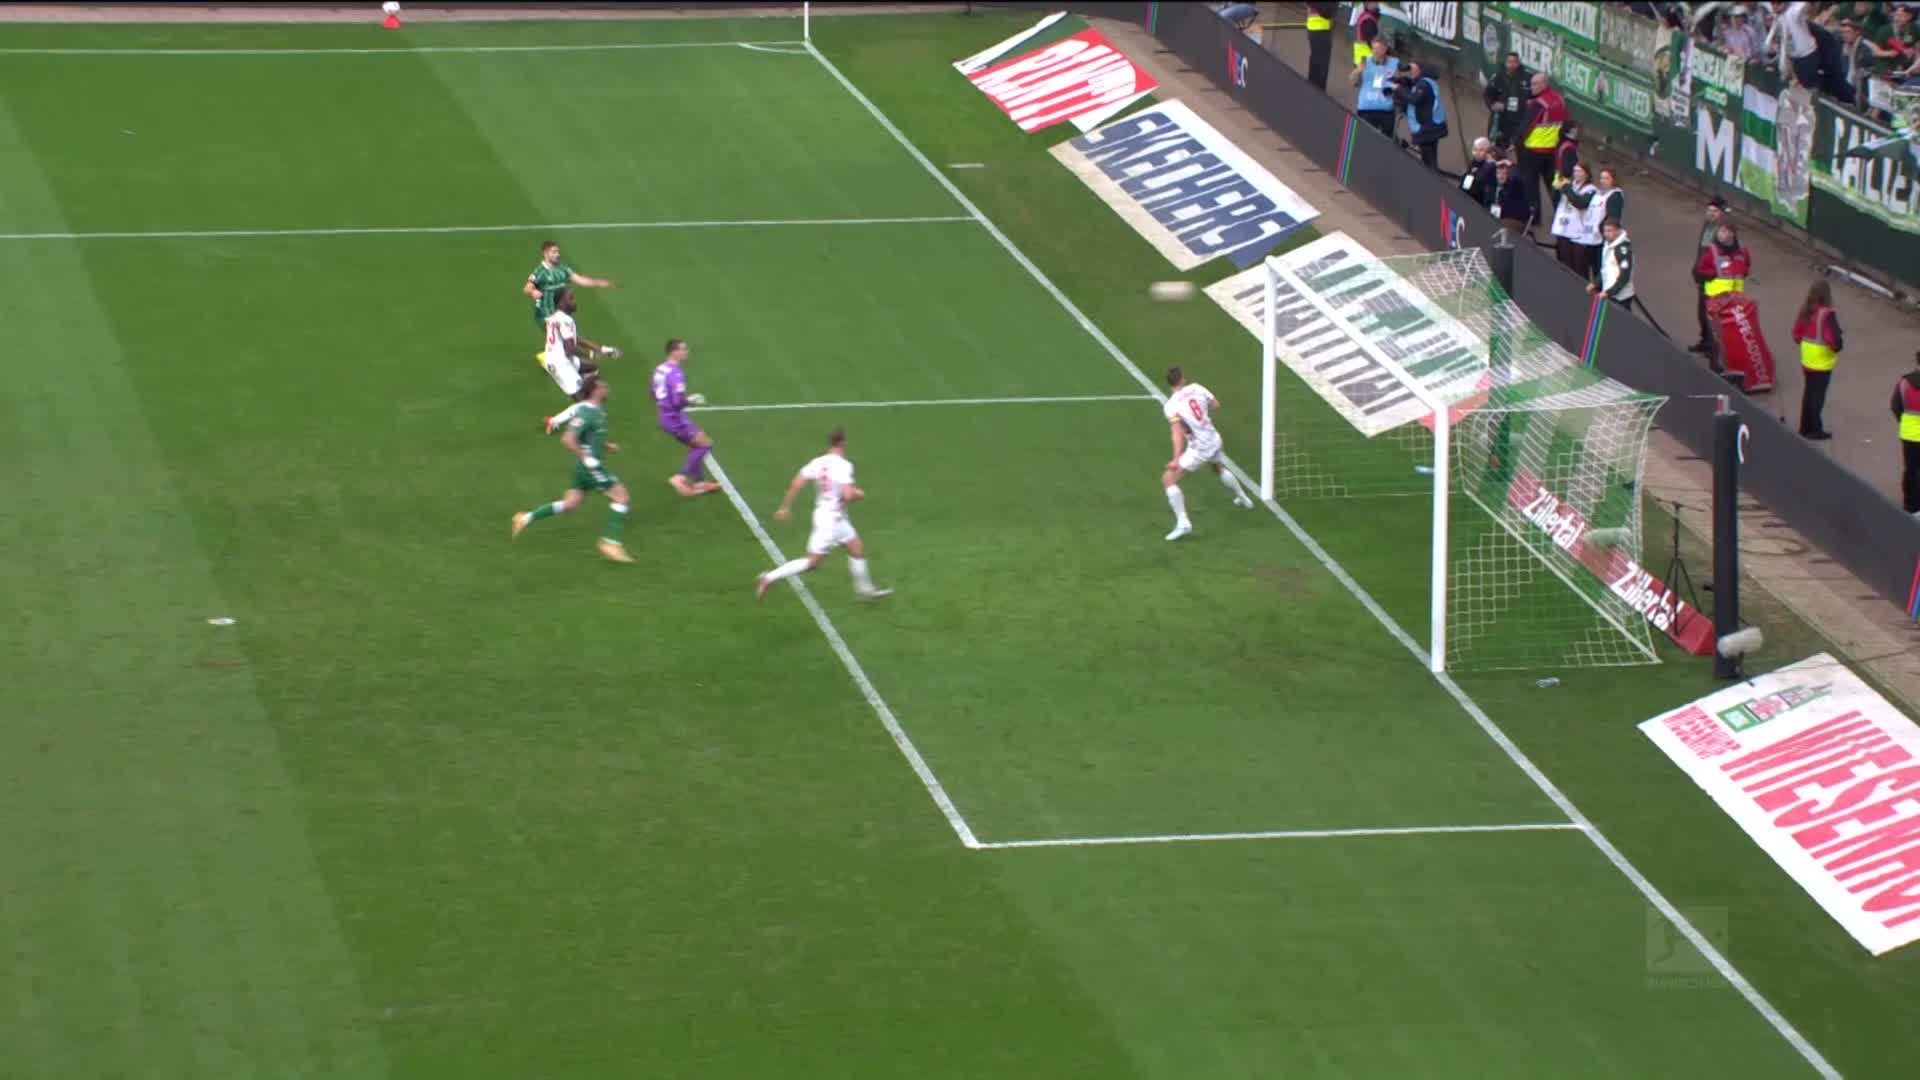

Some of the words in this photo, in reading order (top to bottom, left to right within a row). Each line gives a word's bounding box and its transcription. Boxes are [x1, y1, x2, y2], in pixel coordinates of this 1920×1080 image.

[1069, 111, 1300, 256] SKECHERS
[1696, 105, 1742, 188] M
[1523, 486, 1585, 549] Zillertal
[1610, 560, 1684, 632] Zillertal
[1720, 710, 1920, 929] WIESENH
